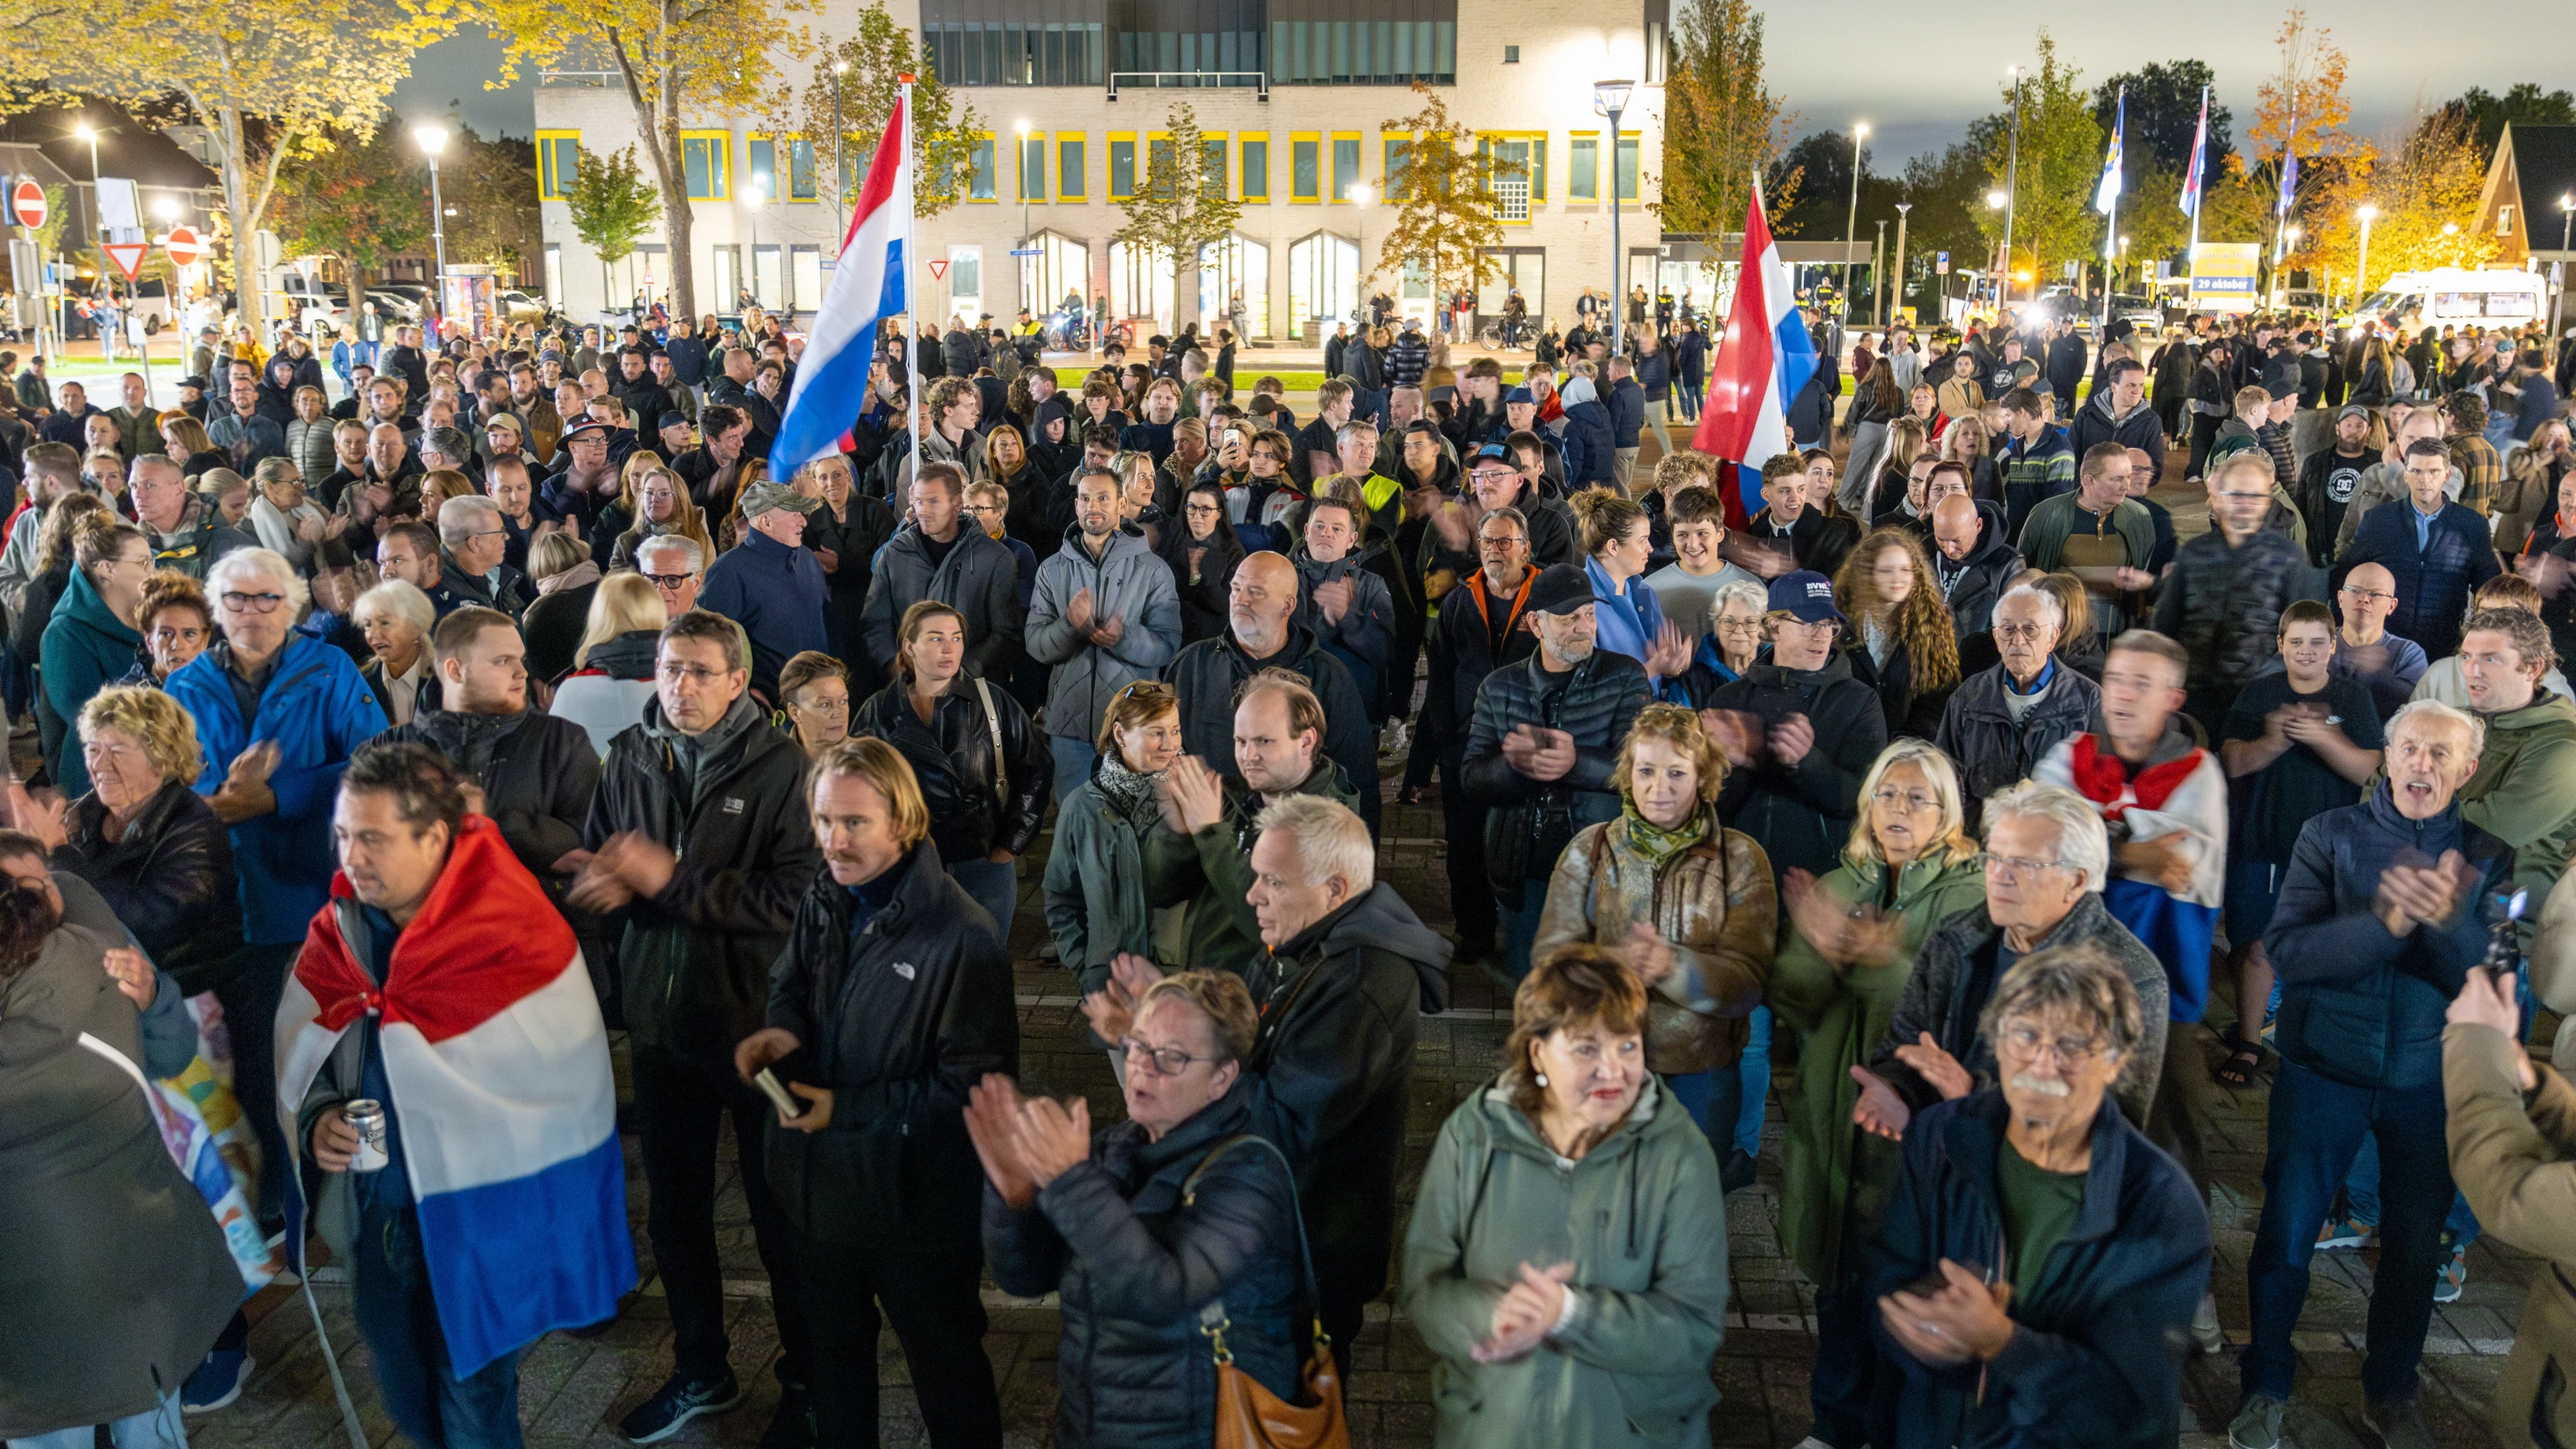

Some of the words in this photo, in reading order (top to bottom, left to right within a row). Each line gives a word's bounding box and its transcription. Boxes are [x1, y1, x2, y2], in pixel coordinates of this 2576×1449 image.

[1939, 252, 1946, 262] P
[2198, 279, 2210, 289] 29
[2211, 278, 2249, 289] oktober
[2336, 479, 2353, 492] DC
